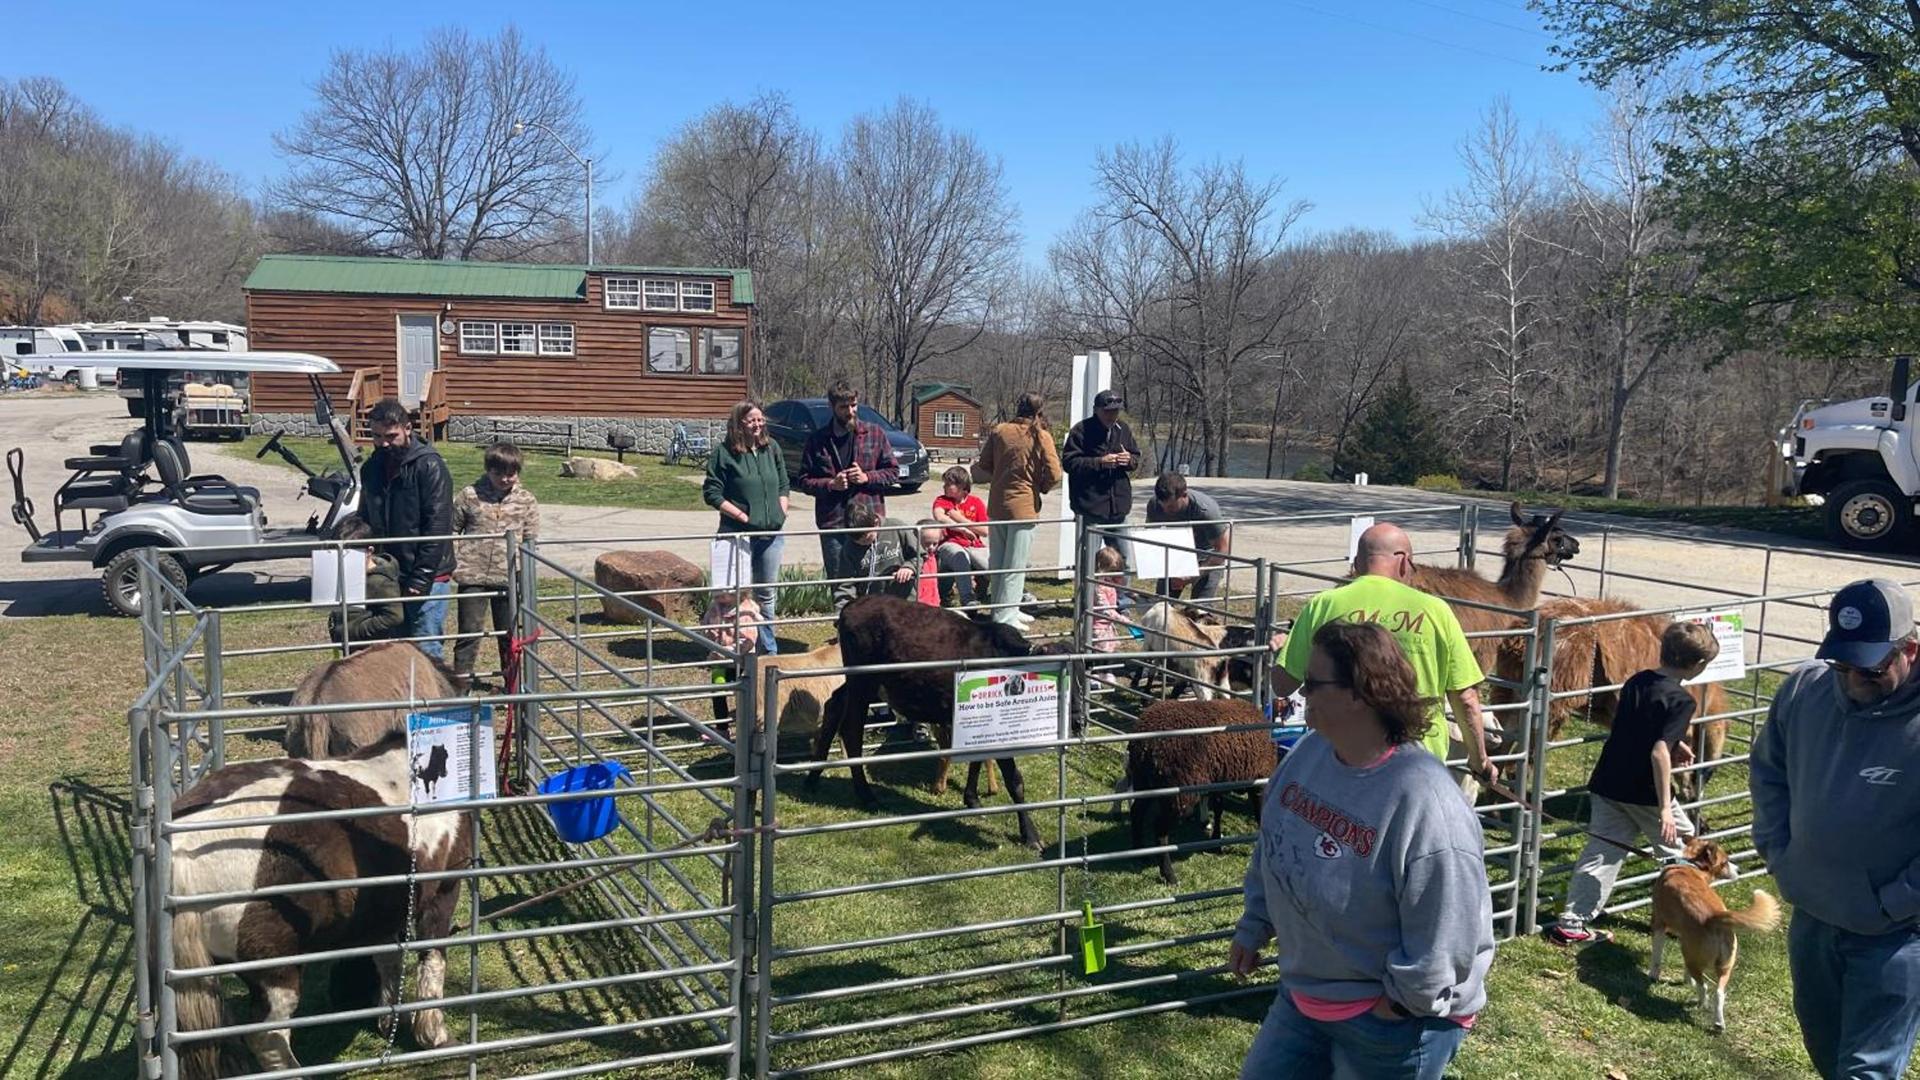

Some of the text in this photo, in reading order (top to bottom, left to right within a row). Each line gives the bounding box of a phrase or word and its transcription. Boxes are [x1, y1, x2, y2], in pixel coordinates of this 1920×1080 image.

[1391, 611, 1425, 635] M
[958, 702, 976, 712] How
[976, 701, 984, 710] to
[985, 700, 994, 709] be
[995, 698, 1011, 707] Safe
[1012, 695, 1038, 706] Around
[1280, 782, 1377, 858] CHAMPIONS
[1320, 836, 1338, 857] KC
